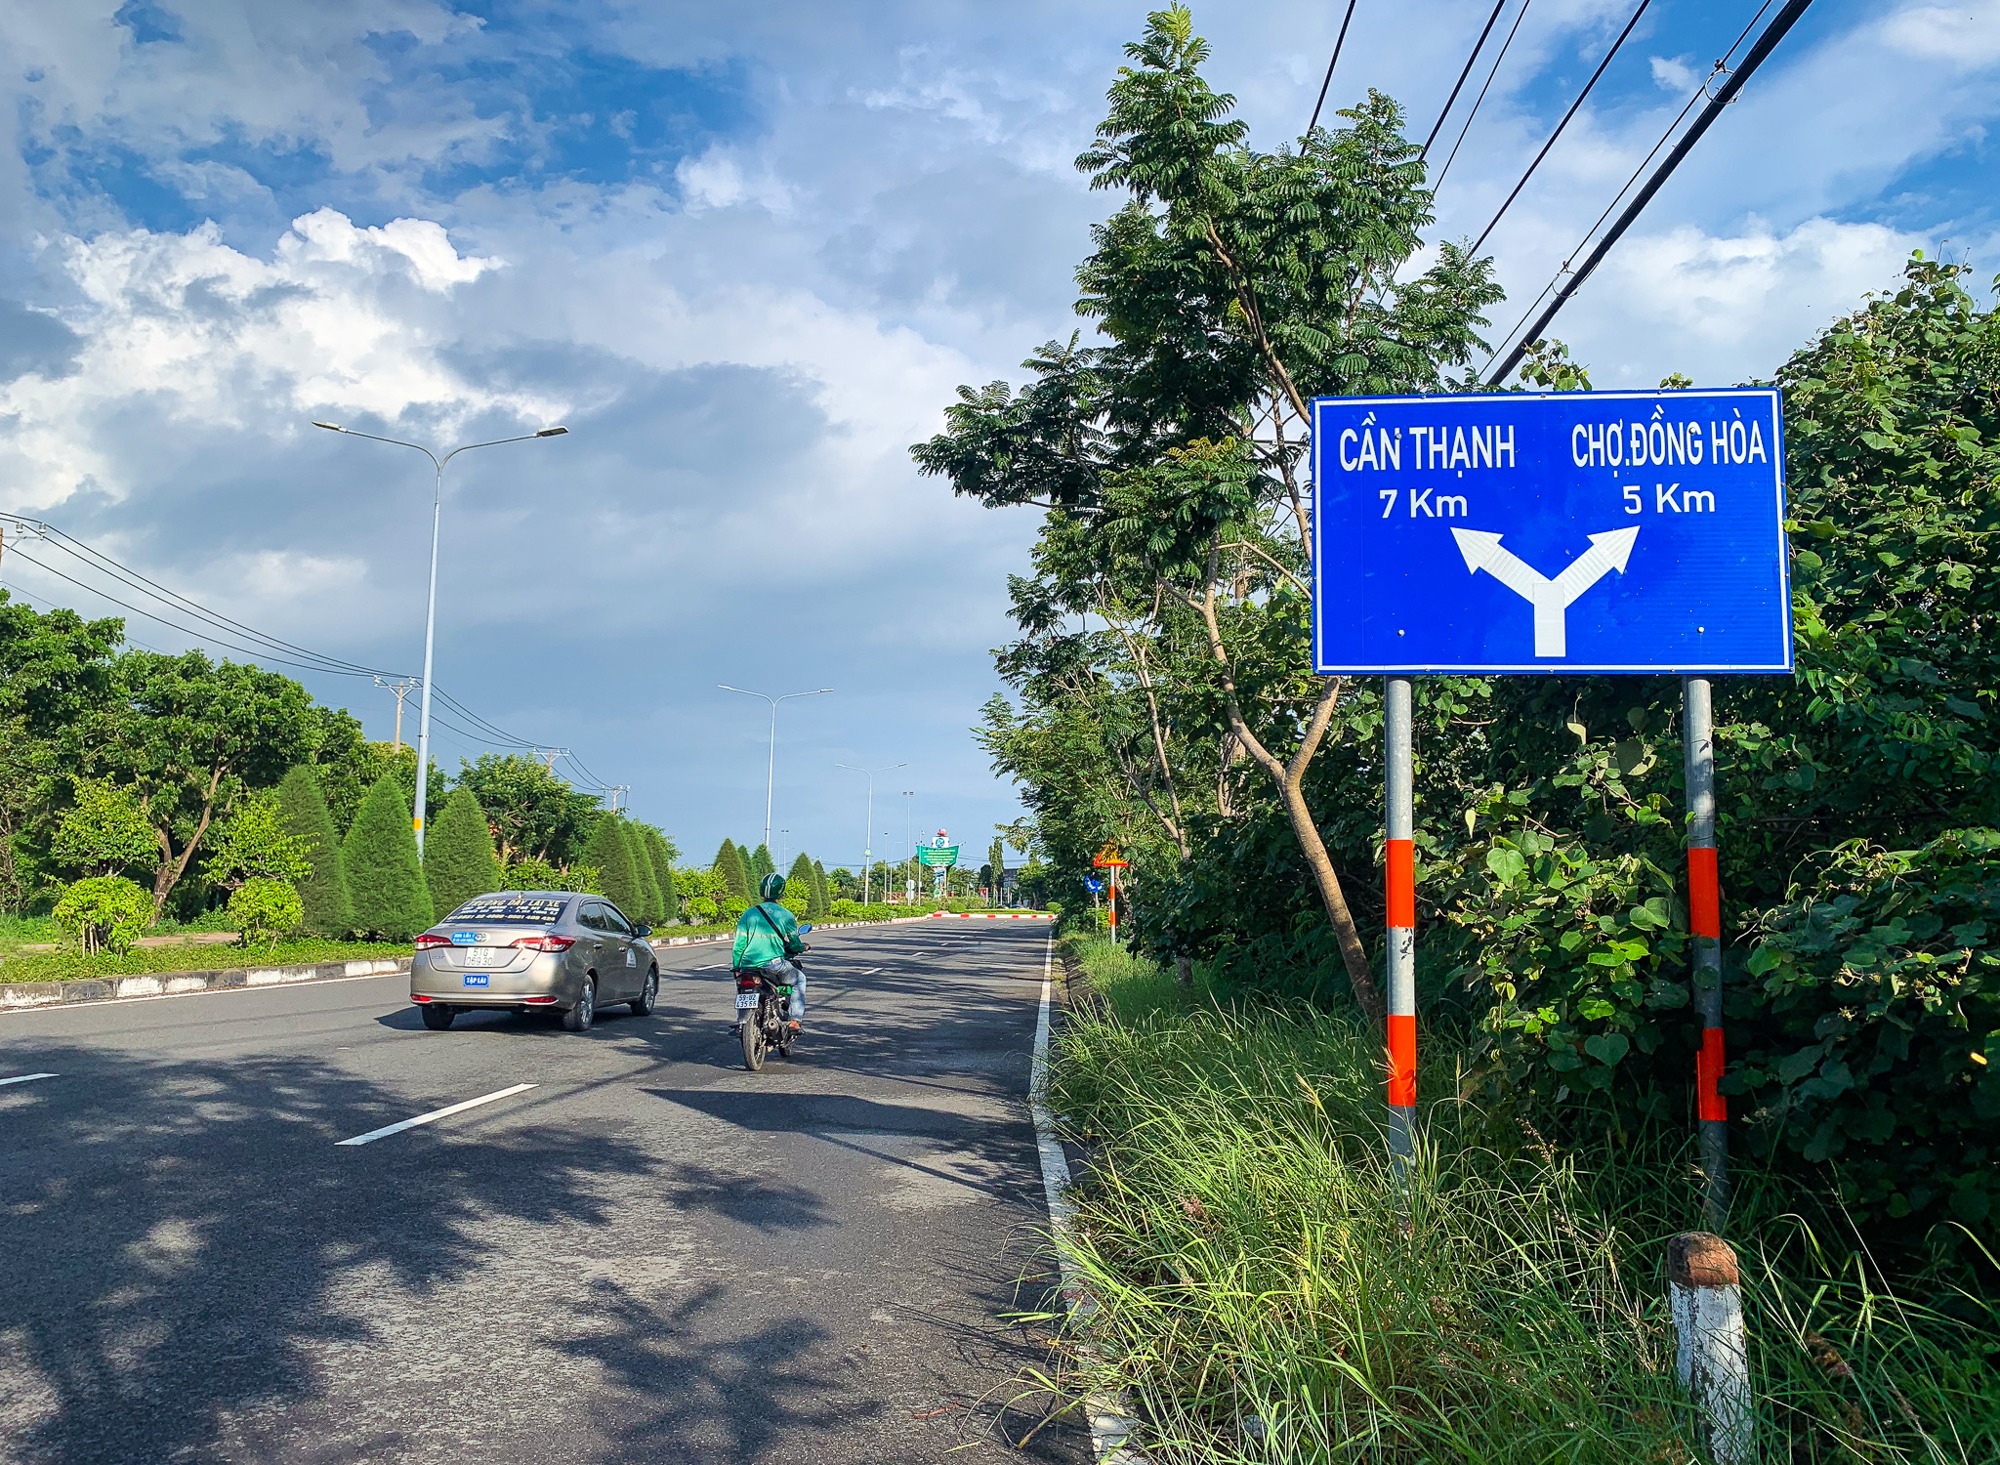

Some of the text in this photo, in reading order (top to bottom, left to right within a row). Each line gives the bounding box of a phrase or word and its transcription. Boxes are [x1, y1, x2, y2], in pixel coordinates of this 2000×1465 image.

[1339, 411, 1517, 479] CẦN THẠNH
[1711, 407, 1768, 466] HÒA
[1379, 487, 1469, 519] 7 Km
[1623, 482, 1717, 516] 5 Km
[473, 947, 489, 957] 51G
